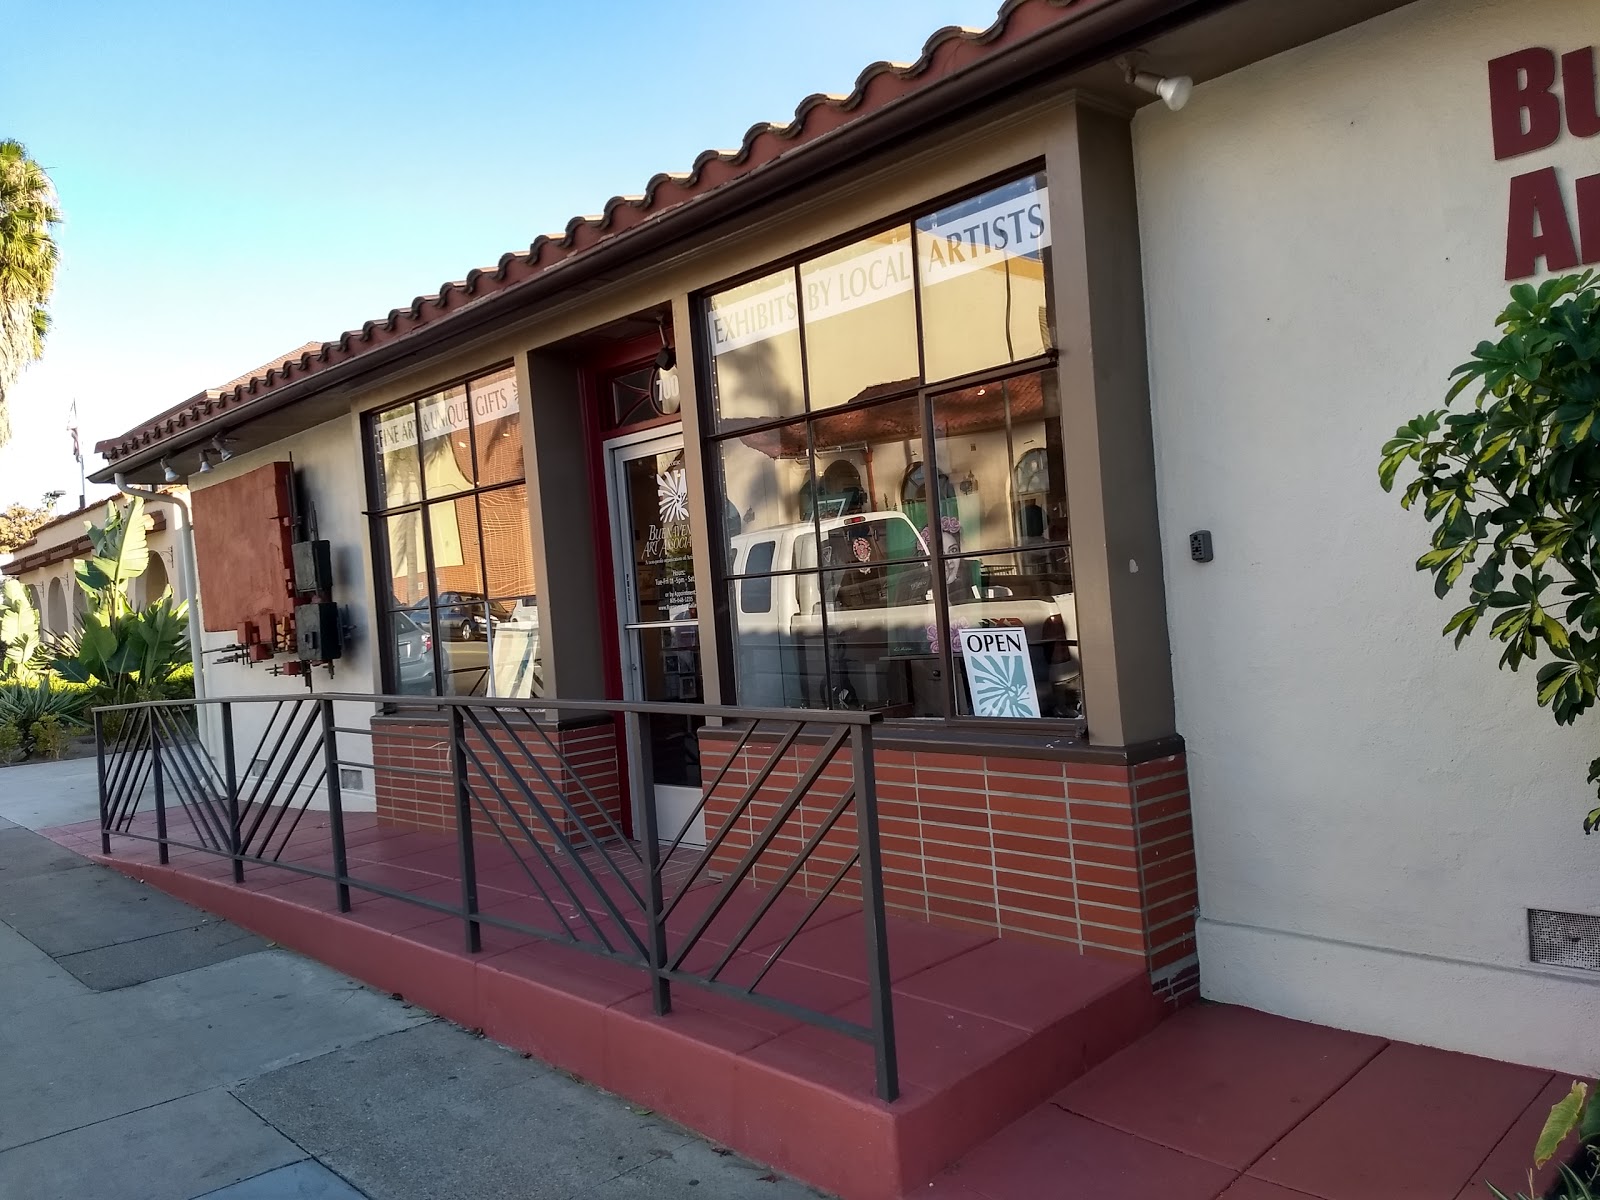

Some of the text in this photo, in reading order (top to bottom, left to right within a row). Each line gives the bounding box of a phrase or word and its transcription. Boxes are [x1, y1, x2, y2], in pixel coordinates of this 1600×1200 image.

[714, 203, 1046, 345] EXHIBITS BY LOCAL ARTISTS
[656, 374, 680, 402] 700
[378, 425, 400, 448] FINE
[423, 414, 430, 433] &
[430, 401, 469, 430] UNIQUE
[475, 388, 508, 417] GIFTS
[641, 540, 660, 560] ART
[966, 634, 1022, 653] OPEN
